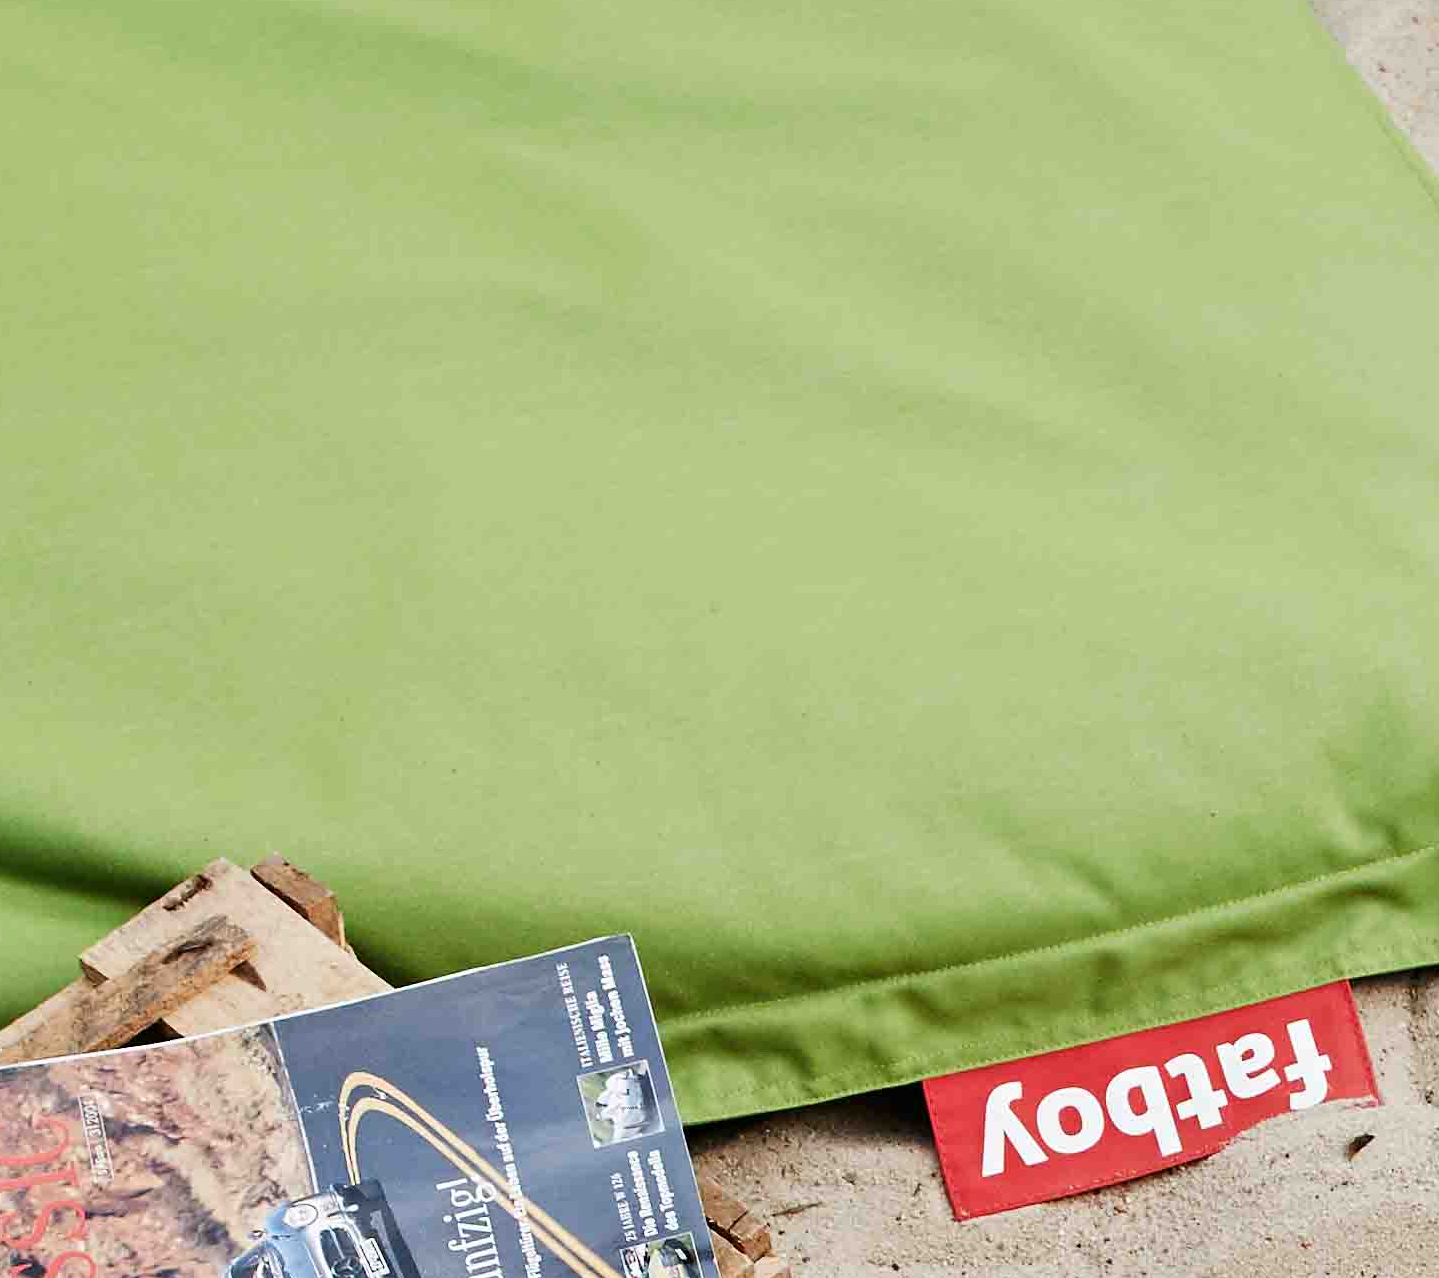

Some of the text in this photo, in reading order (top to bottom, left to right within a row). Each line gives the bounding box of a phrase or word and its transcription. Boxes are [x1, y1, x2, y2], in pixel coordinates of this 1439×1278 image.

[555, 961, 575, 996] REISE
[617, 1035, 634, 1057] mit
[981, 1018, 1332, 1177] fatboy
[493, 1122, 508, 1142] der
[496, 1142, 513, 1162] auf
[640, 1216, 659, 1236] Die
